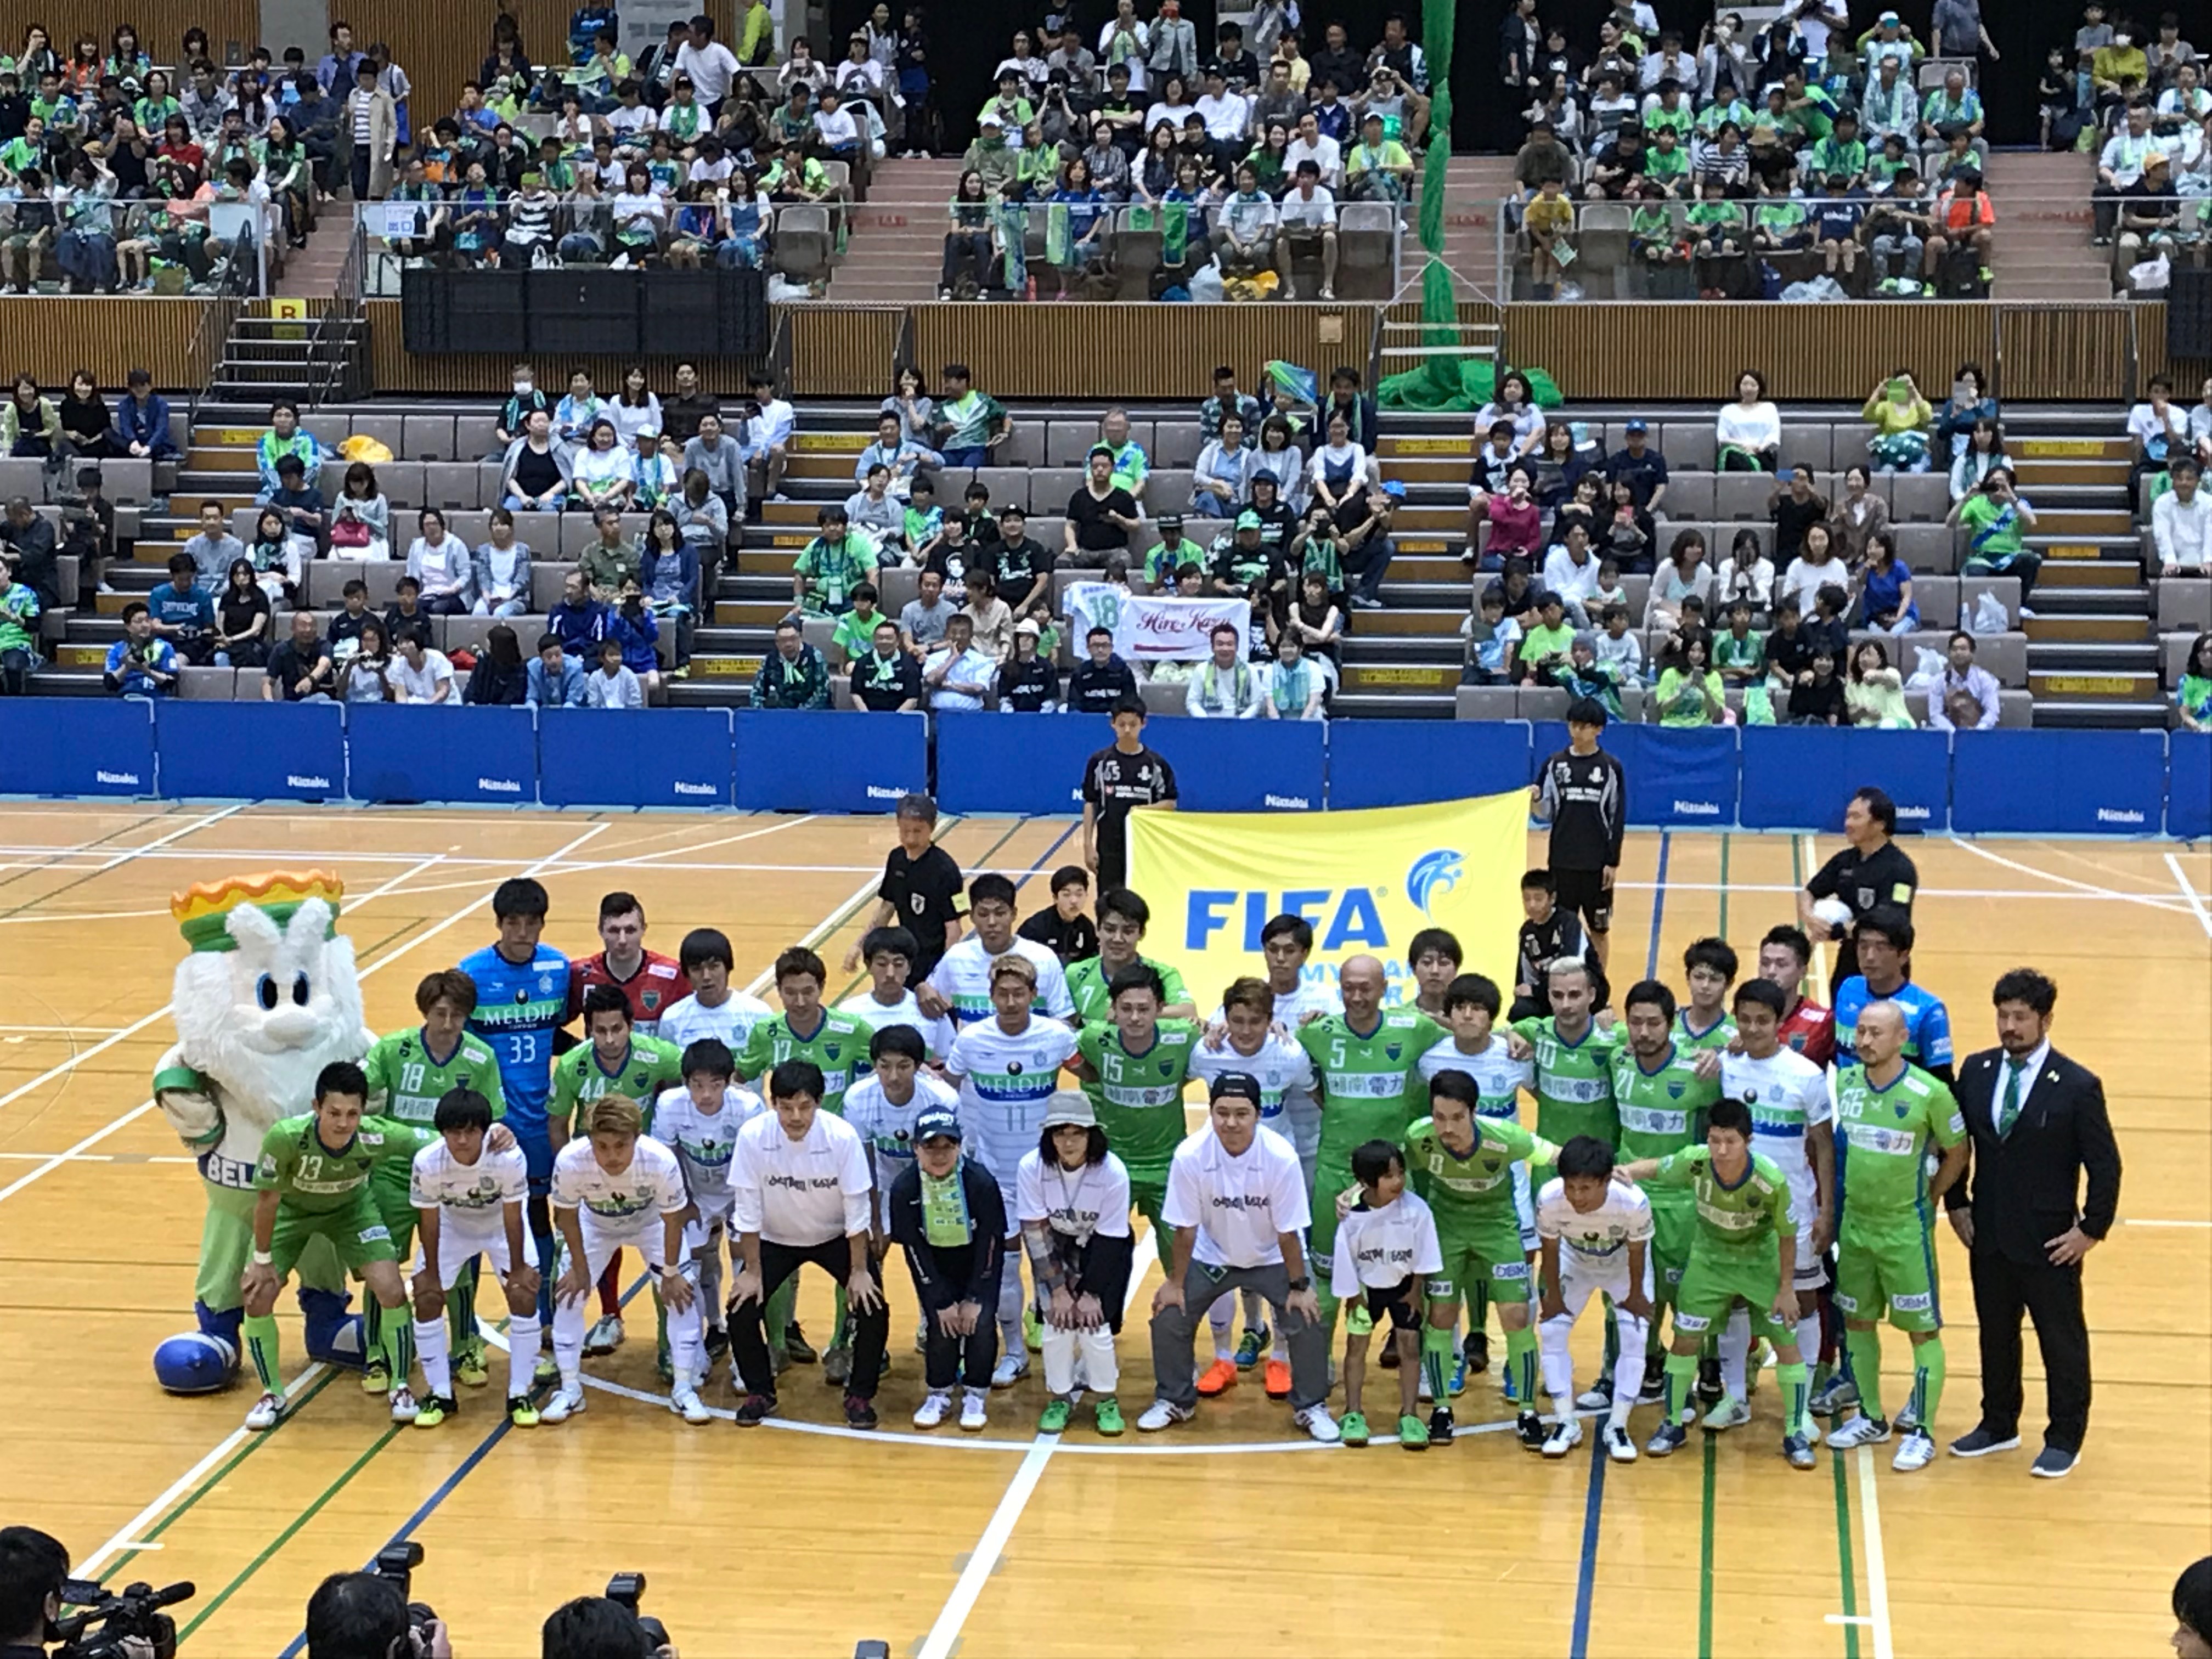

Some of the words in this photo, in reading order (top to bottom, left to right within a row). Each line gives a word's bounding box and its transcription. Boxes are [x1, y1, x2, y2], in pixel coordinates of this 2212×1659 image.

[281, 306, 297, 319] B
[1088, 594, 1118, 628] 18
[1185, 887, 1389, 952] FIFA
[509, 1035, 536, 1064] 33
[772, 1039, 792, 1067] 17
[1330, 1038, 1347, 1069] 5
[1535, 1037, 1559, 1070] 10
[399, 1062, 426, 1093] 18
[1102, 1053, 1125, 1083] 15
[578, 1076, 606, 1102] 44
[1614, 1069, 1637, 1100] 21
[298, 1154, 324, 1181] 13
